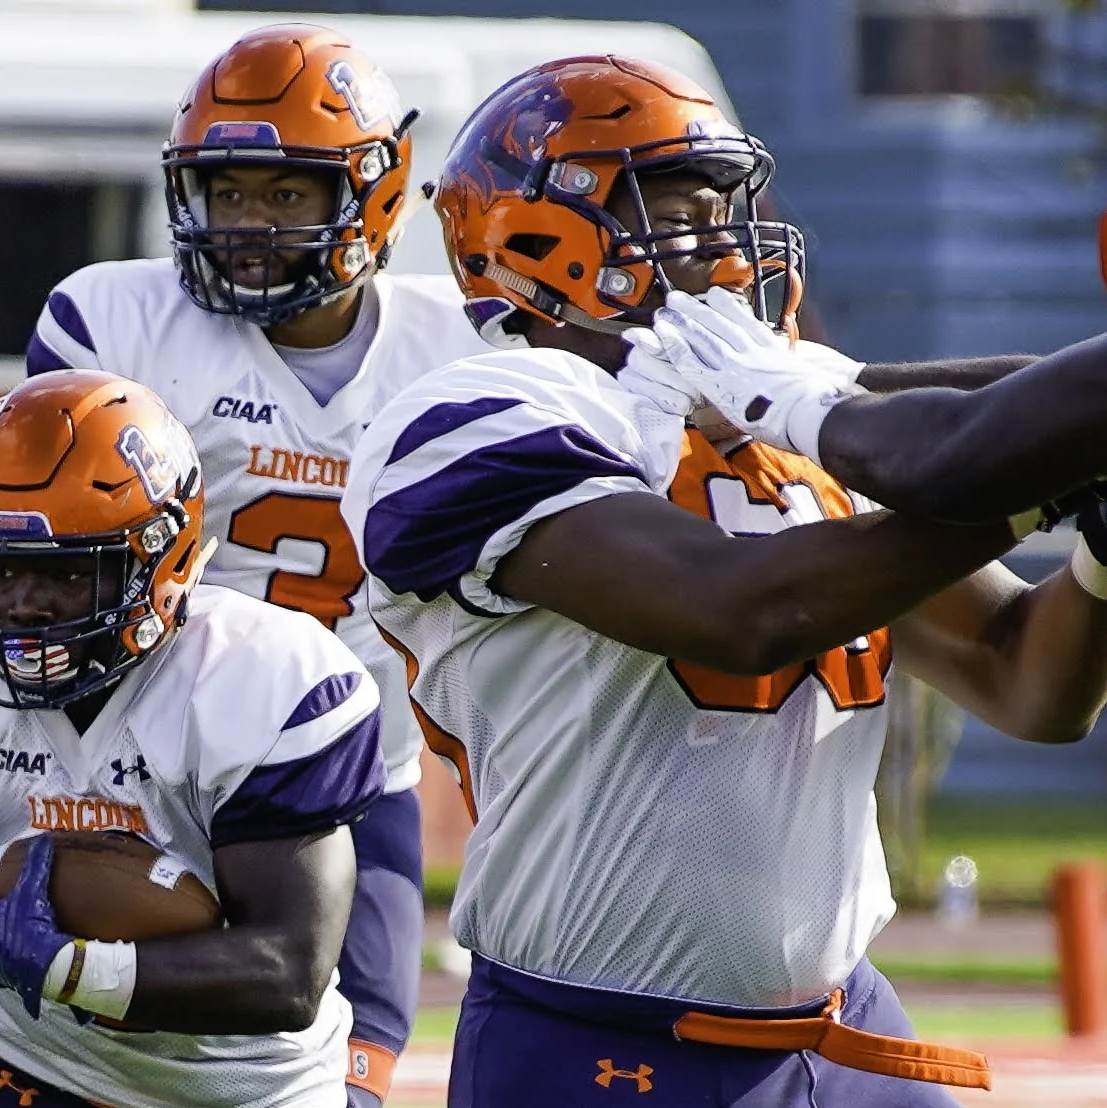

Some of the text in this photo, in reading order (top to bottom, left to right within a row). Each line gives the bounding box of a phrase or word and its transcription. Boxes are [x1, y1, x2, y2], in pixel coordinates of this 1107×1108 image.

[212, 396, 277, 425] CIAA
[246, 445, 350, 487] LINCOL
[28, 795, 150, 834] LINCOLN
